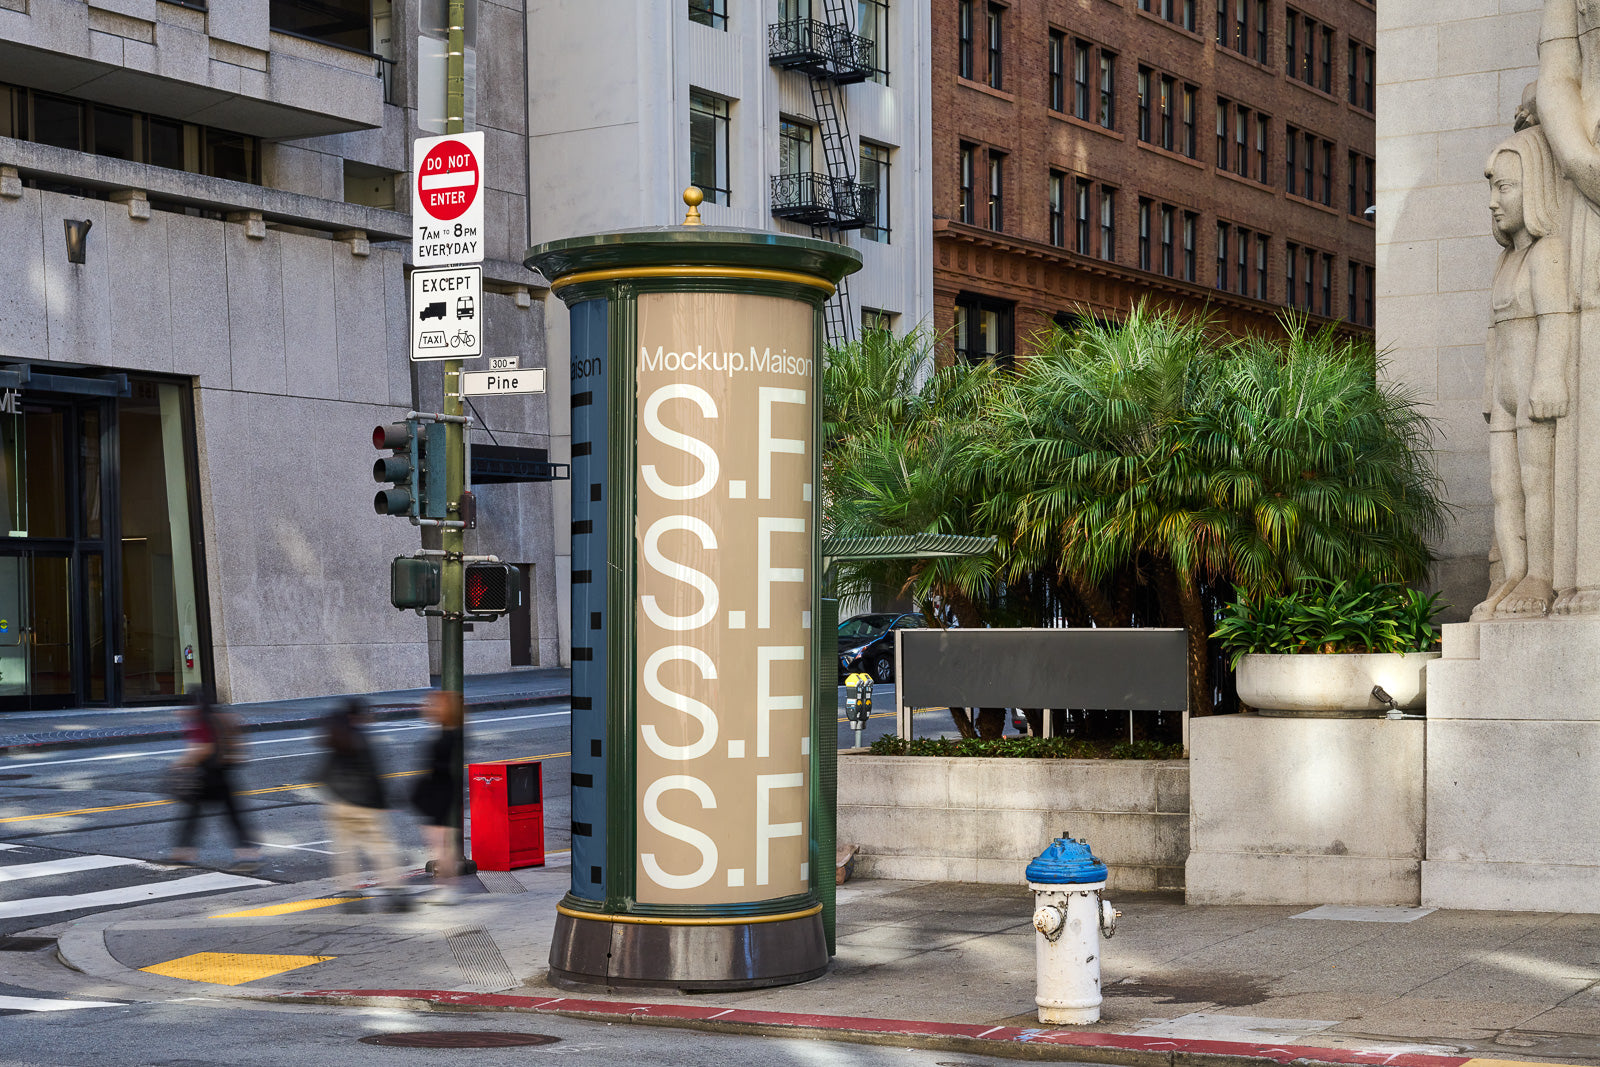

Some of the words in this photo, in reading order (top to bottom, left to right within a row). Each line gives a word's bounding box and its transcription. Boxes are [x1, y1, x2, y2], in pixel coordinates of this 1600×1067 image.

[427, 157, 442, 171] DO
[448, 154, 471, 169] NOT
[430, 191, 466, 207] ENTER
[419, 241, 478, 258] EVERYDAY
[422, 276, 471, 293] EXCEPT
[423, 336, 442, 344] TAXI
[492, 359, 508, 369] 300
[641, 345, 813, 377] Mockup.Maison
[487, 376, 519, 390] Pine
